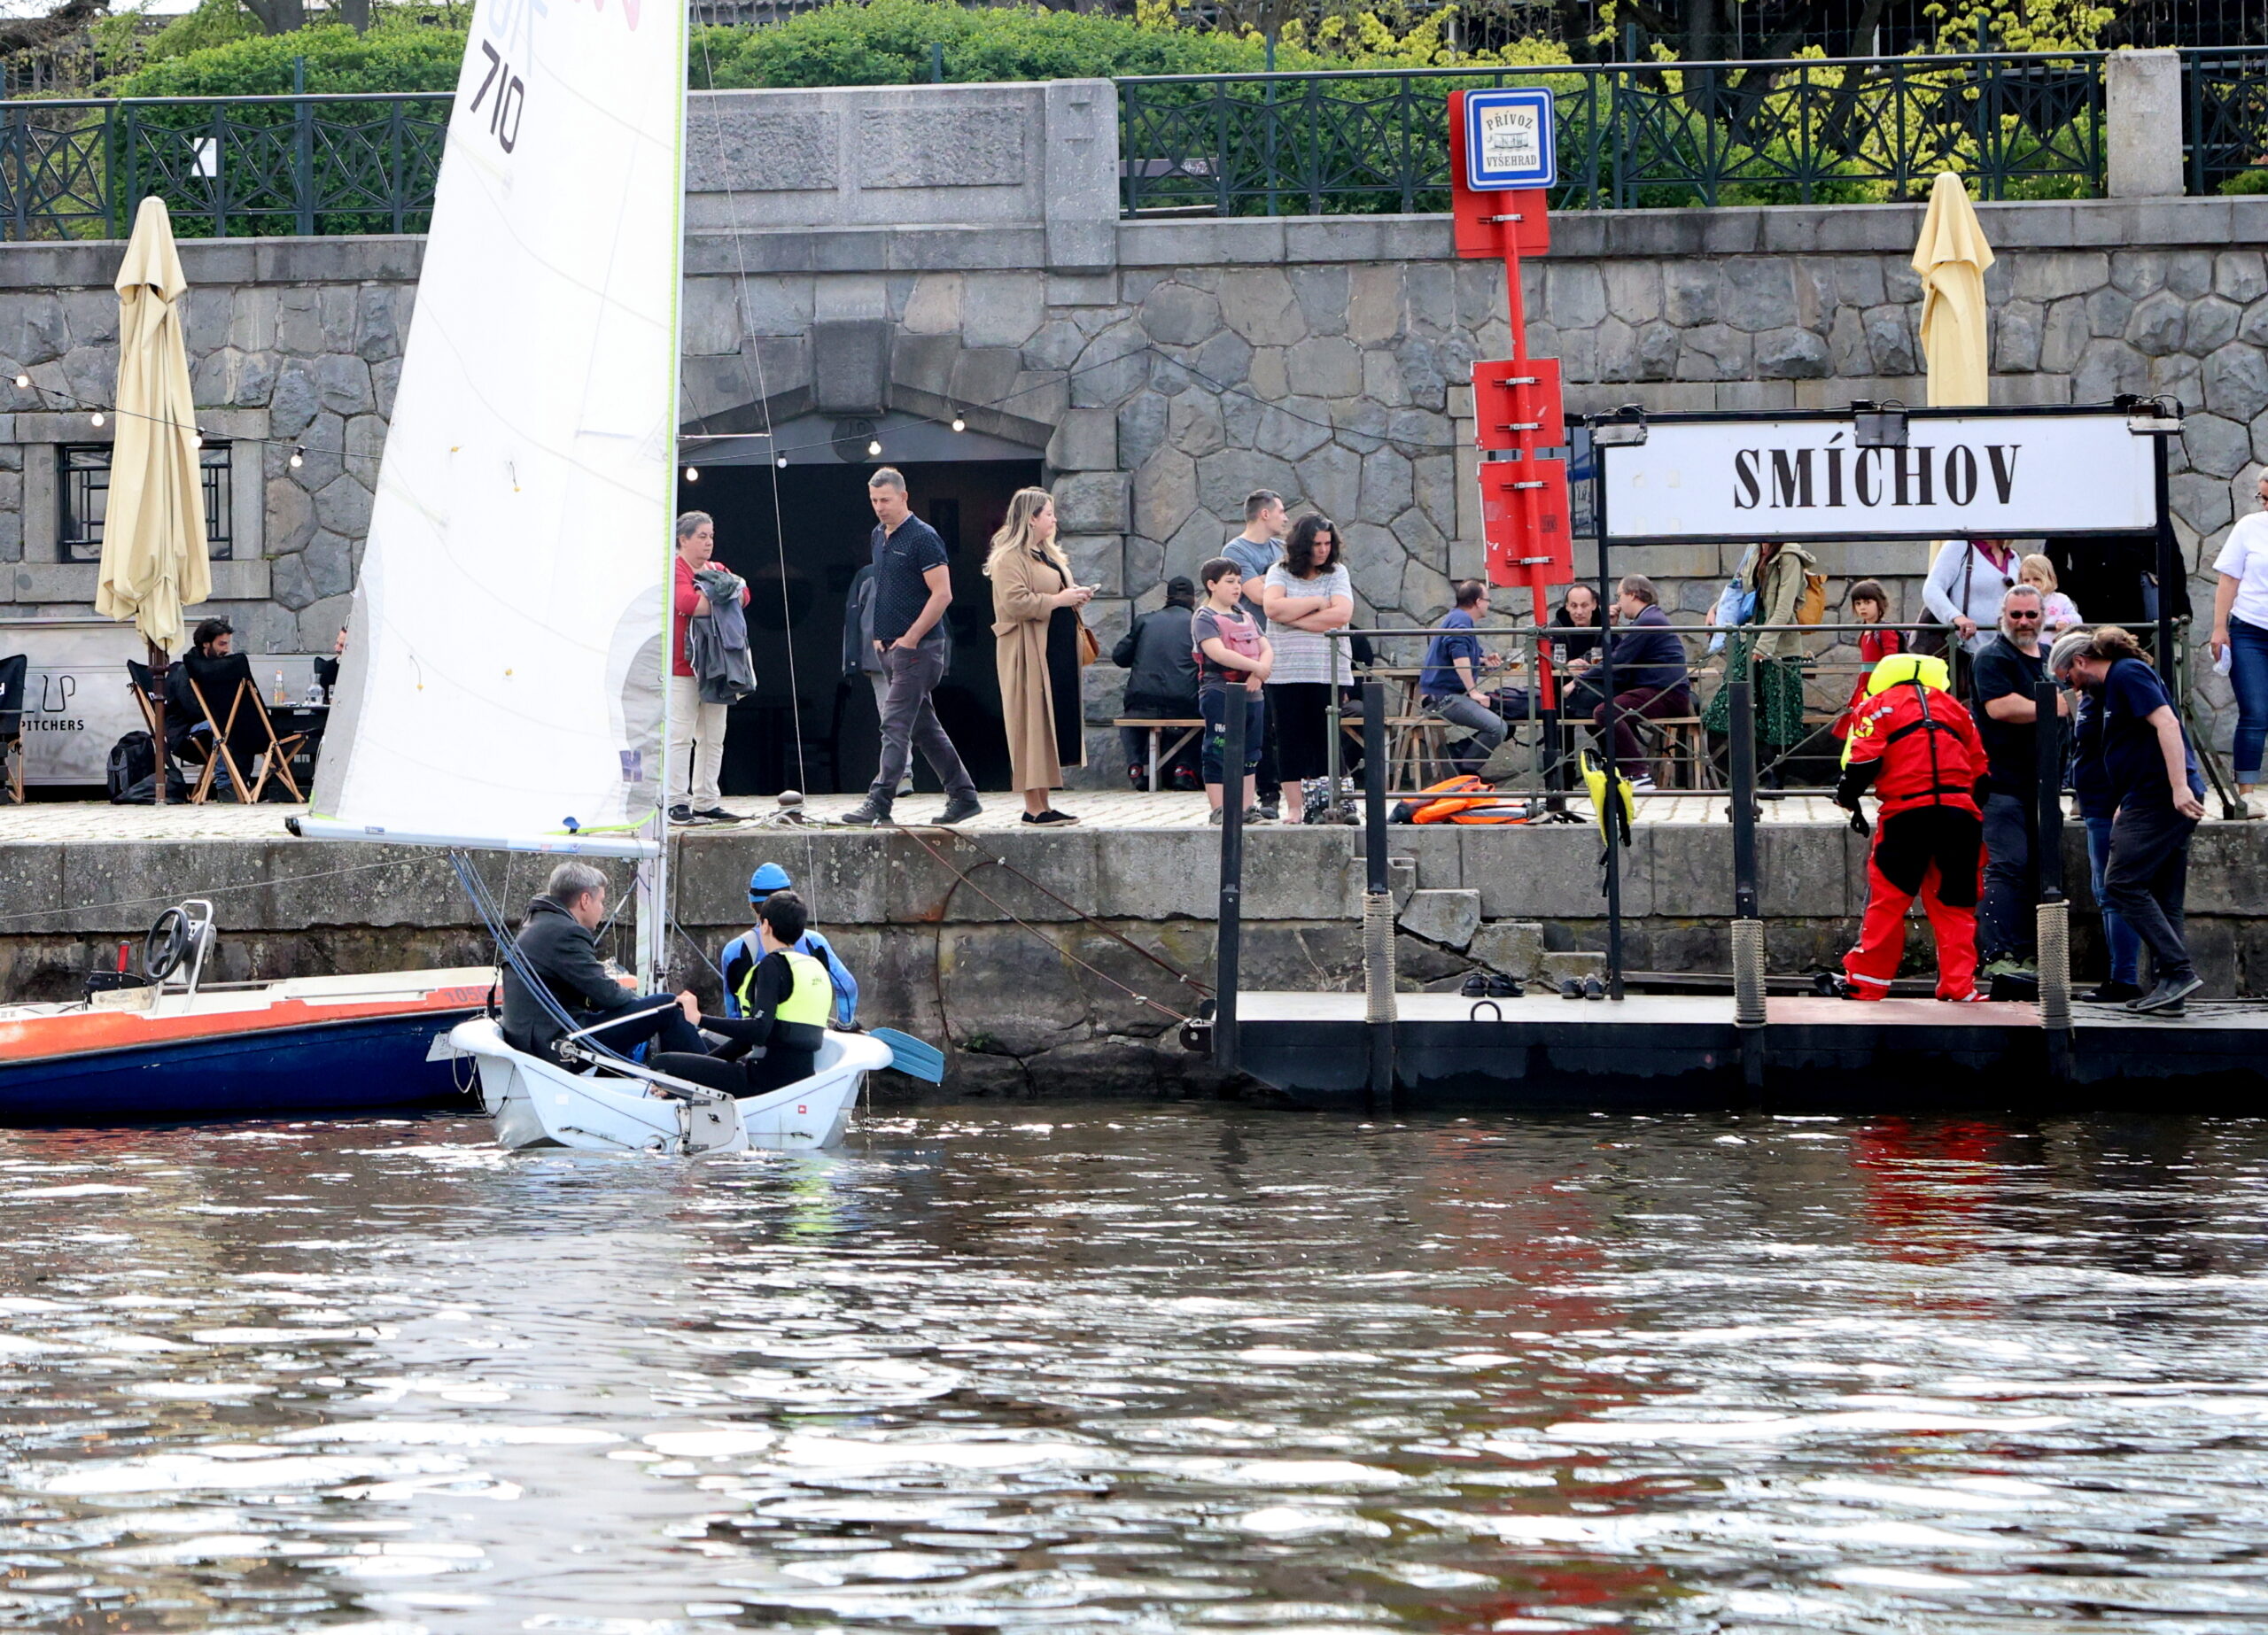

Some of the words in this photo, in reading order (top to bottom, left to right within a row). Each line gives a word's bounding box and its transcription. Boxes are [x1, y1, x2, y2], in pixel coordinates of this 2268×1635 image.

[470, 38, 524, 154] 710
[1486, 111, 1534, 131] PŘÍVOZ
[1486, 153, 1537, 167] VYŠEHRAD
[1734, 430, 2023, 509] SMÍCHOV
